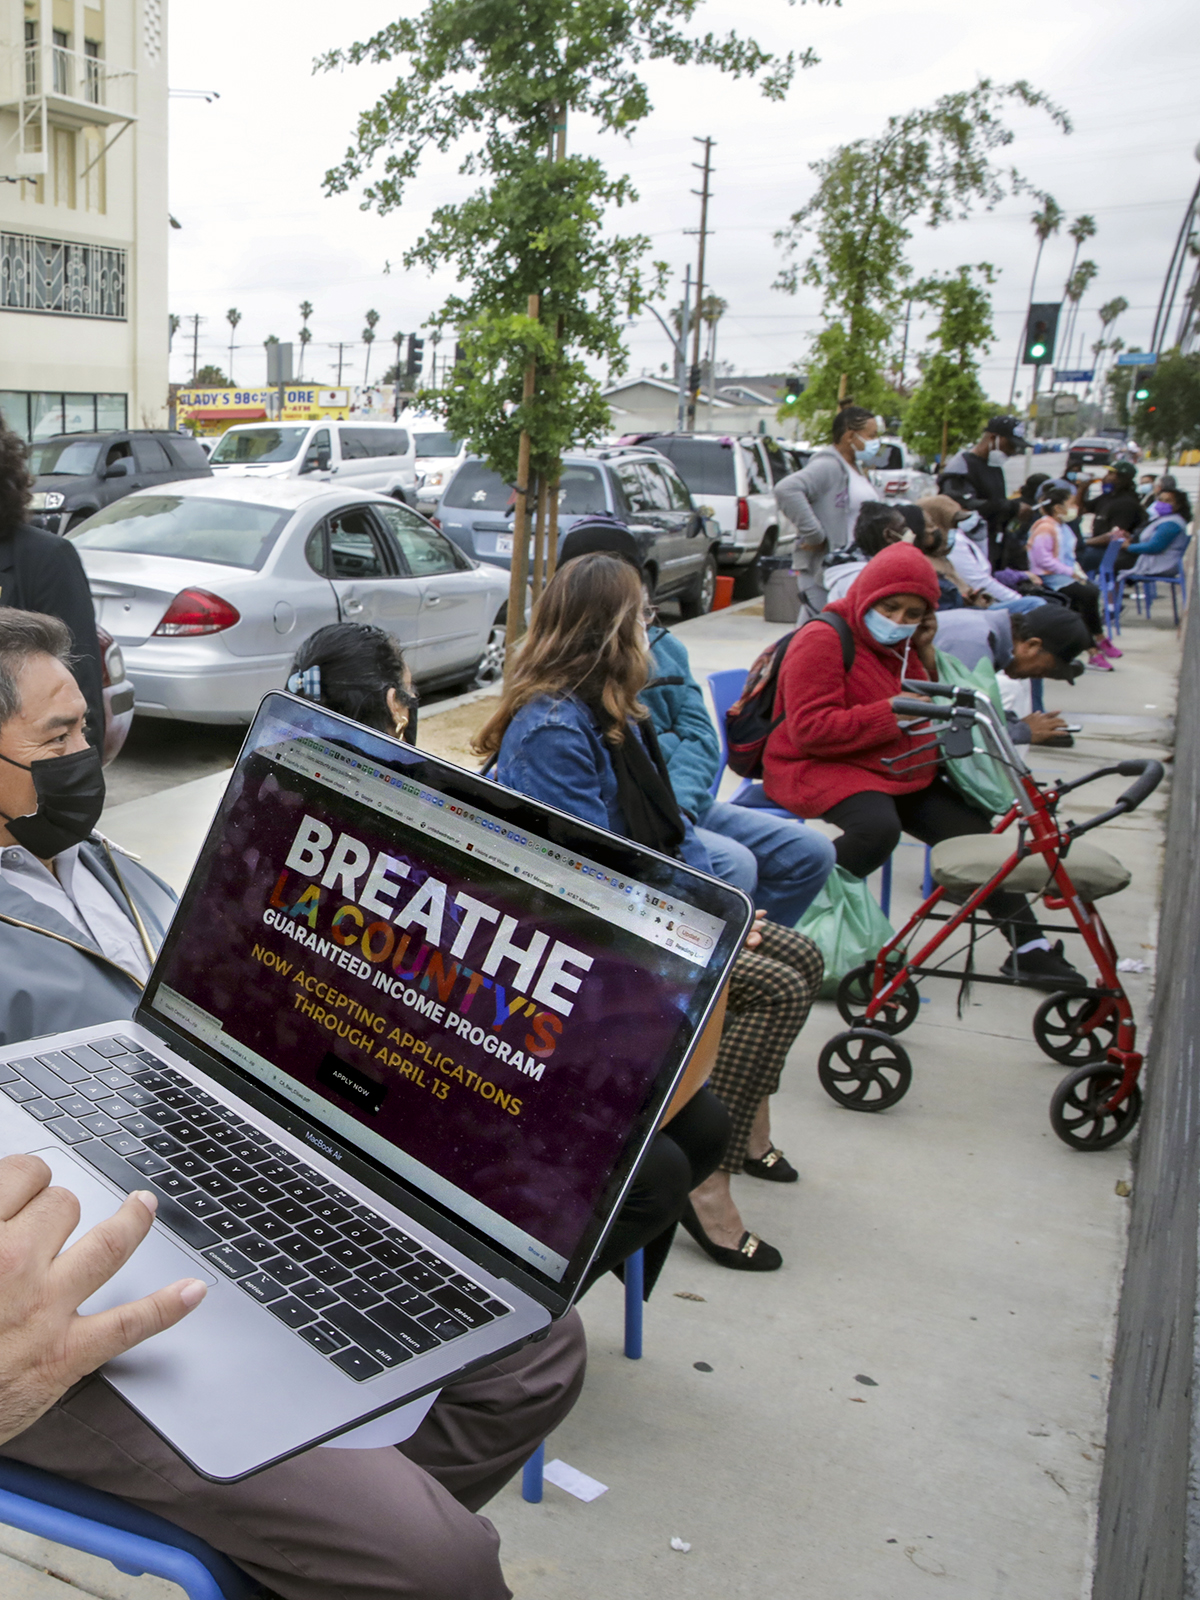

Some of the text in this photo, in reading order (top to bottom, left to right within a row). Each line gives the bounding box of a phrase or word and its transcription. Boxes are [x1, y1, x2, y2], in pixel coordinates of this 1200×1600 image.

[270, 869, 321, 929] LA
[285, 814, 594, 1017] BREATHE
[263, 908, 546, 1082] GUARANTEED INCOME PROGRAM
[251, 943, 293, 976] NOW
[292, 970, 387, 1033] ACCEPTING
[387, 1027, 523, 1116] APPLICATIONS
[294, 993, 451, 1100] THROUGH APRIL 13
[333, 1070, 370, 1097] APPLY NOW
[305, 1131, 343, 1162] MacBook Air
[209, 1251, 238, 1274] command
[244, 1280, 265, 1297] option
[454, 1307, 474, 1323] delete
[400, 1332, 421, 1348] return
[375, 1348, 393, 1362] shift
